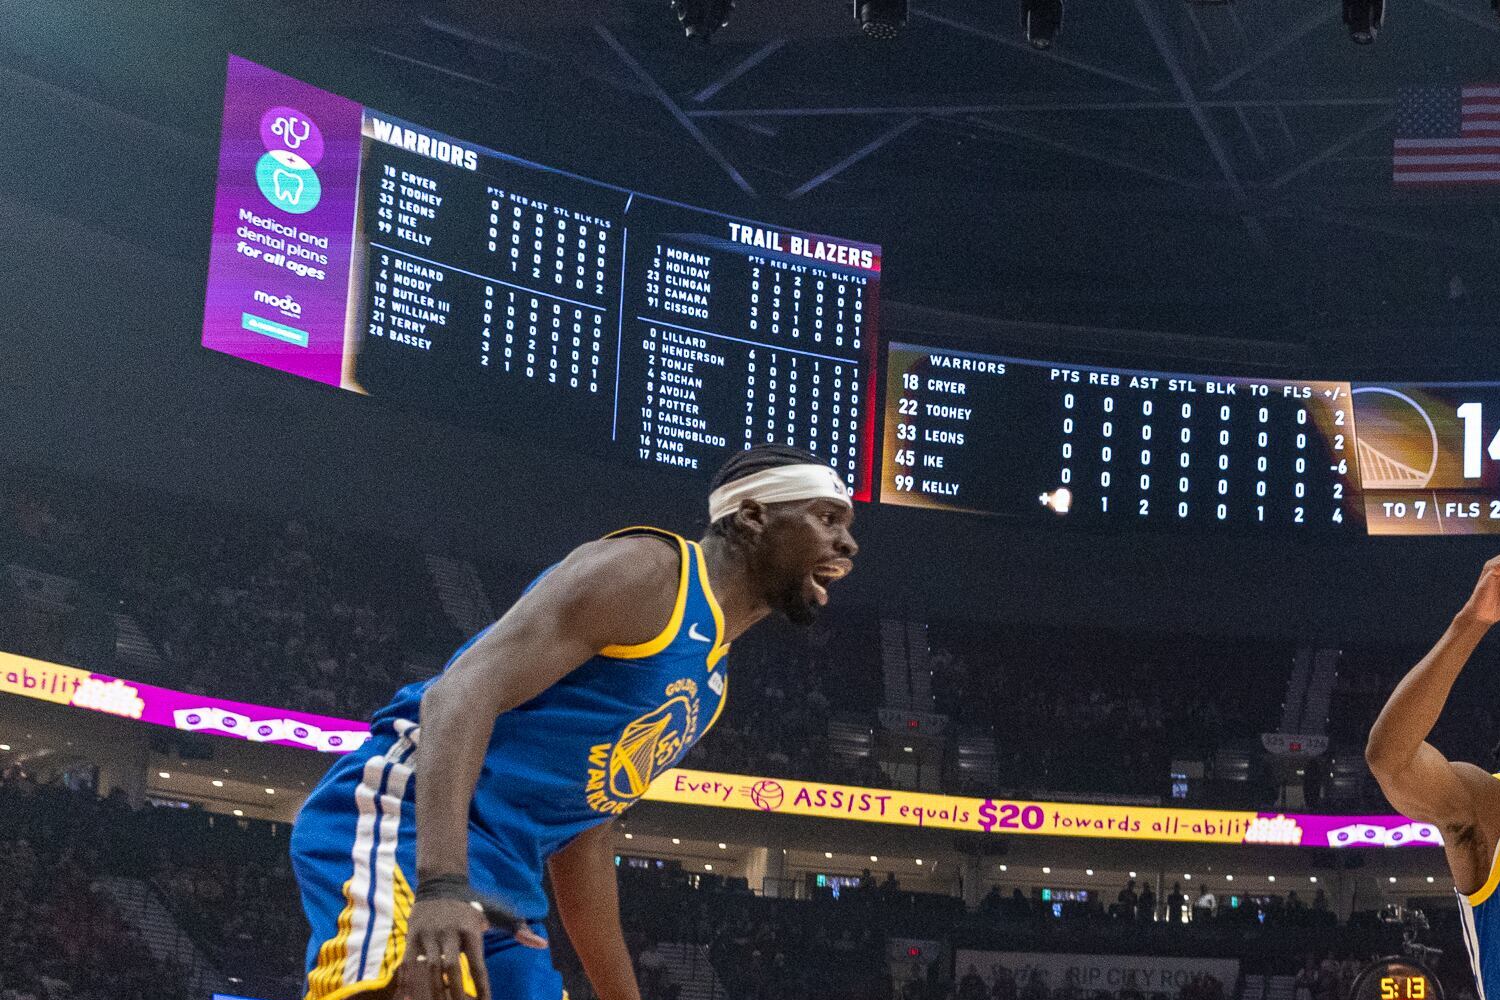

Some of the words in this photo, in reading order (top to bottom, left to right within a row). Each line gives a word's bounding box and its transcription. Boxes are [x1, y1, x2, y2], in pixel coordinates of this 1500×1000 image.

[373, 118, 477, 171] WARRIORS
[401, 171, 437, 191] CRYER
[400, 184, 442, 207] TOOHEY
[400, 199, 435, 219] LEONS
[239, 208, 297, 238] Medical
[299, 232, 328, 249] and
[398, 213, 417, 228] IKE
[236, 226, 285, 251] dental
[287, 244, 328, 265] plans
[397, 227, 432, 246] KELLY
[729, 222, 783, 252] TRAIL
[790, 236, 873, 269] BLAZERS
[237, 241, 262, 258] for
[263, 252, 285, 267] all
[286, 260, 326, 280] ages
[667, 247, 711, 267] MORANT
[666, 261, 710, 280] HOLIDAY
[665, 274, 711, 293] CLINGAN
[254, 290, 302, 314] moda
[665, 288, 707, 306] CAMARA
[664, 301, 708, 319] CISSOKO
[930, 355, 1006, 374] WARRIORS
[902, 373, 919, 390] 18
[927, 379, 966, 395] CRYER
[1050, 368, 1080, 383] PTS
[1089, 372, 1120, 387] REB
[1130, 376, 1159, 391] AST
[1168, 379, 1196, 393] STL
[1206, 382, 1236, 396] BLK
[1250, 384, 1269, 397] TO
[1283, 386, 1312, 399] FLS
[898, 398, 918, 416] 22
[925, 403, 972, 421] TOOHEY
[896, 424, 916, 441] 33
[925, 429, 965, 445] LEONS
[894, 449, 915, 467] 45
[923, 454, 944, 469] IKE
[894, 475, 914, 492] 99
[922, 480, 959, 496] KELLY
[1382, 504, 1406, 518] TO
[1414, 502, 1426, 519] 7
[1445, 502, 1480, 518] FLS
[674, 776, 733, 800] Every
[794, 787, 892, 816] ASSIST
[899, 804, 970, 826] equals
[978, 798, 1044, 832] $20
[1053, 811, 1140, 832] towards
[1381, 977, 1425, 1000] 5:13
